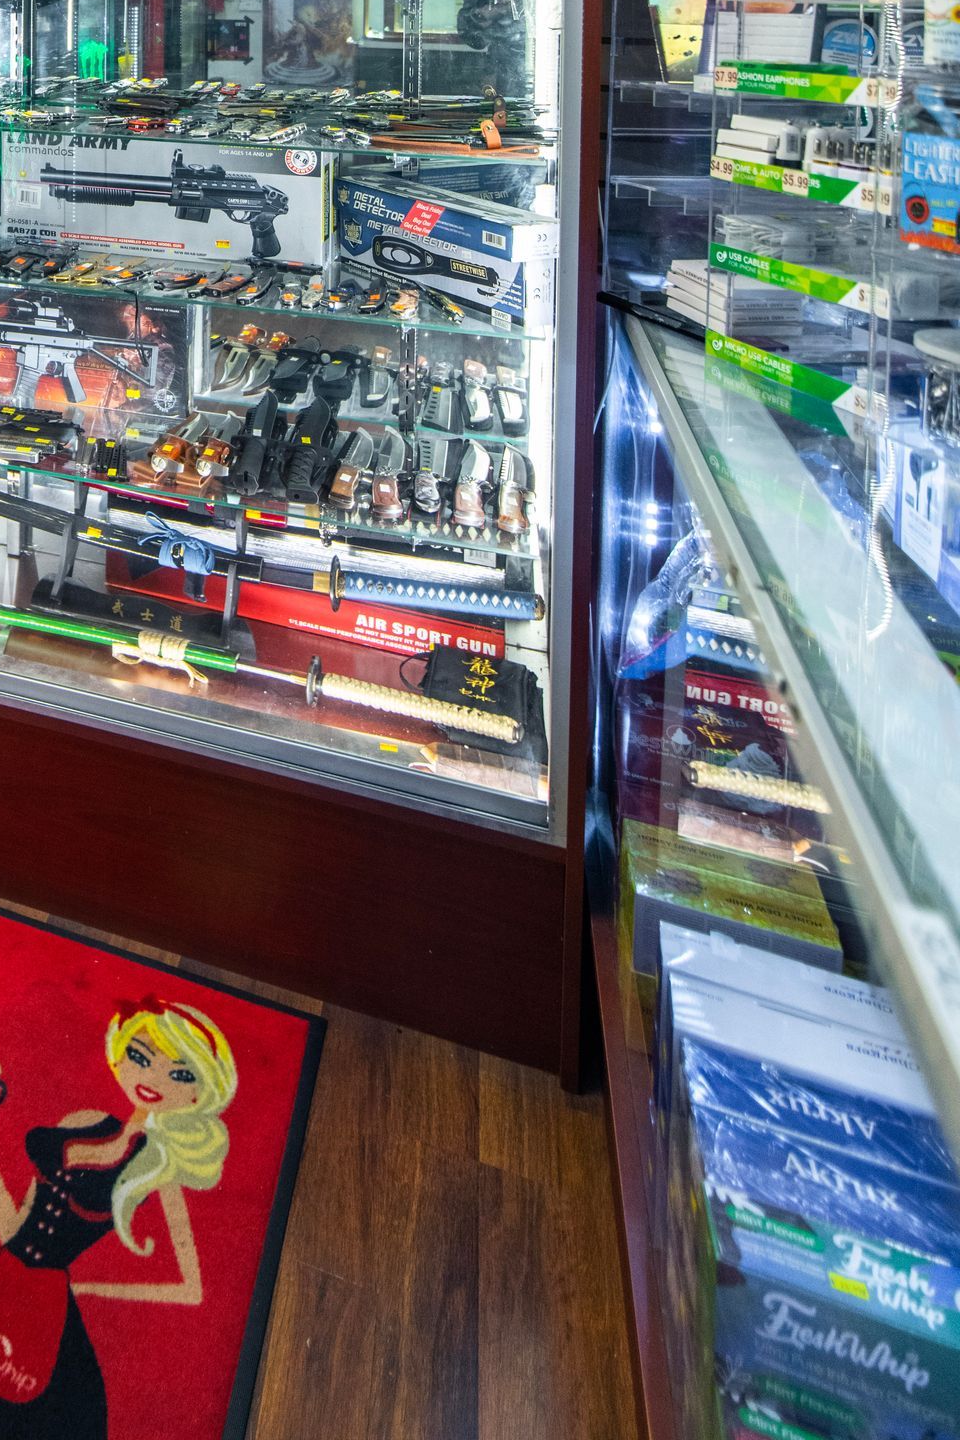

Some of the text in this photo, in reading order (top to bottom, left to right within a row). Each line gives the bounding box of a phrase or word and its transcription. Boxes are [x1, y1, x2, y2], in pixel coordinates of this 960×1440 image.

[715, 71, 737, 84] $7.99
[765, 74, 811, 88] EARPHONES
[8, 144, 76, 157] commandos
[710, 159, 733, 175] $4.99
[783, 173, 809, 191] $5.99
[354, 191, 386, 208] METAL
[353, 200, 405, 222] DETECTOR
[367, 219, 458, 253] METAL DETECTOR
[452, 260, 487, 278] STREETWISE
[728, 251, 770, 271] USB CABLES
[724, 340, 791, 373] MICRO USB CABLES
[356, 613, 497, 657] AIR SPORT GUN
[784, 1152, 904, 1214] Akrux
